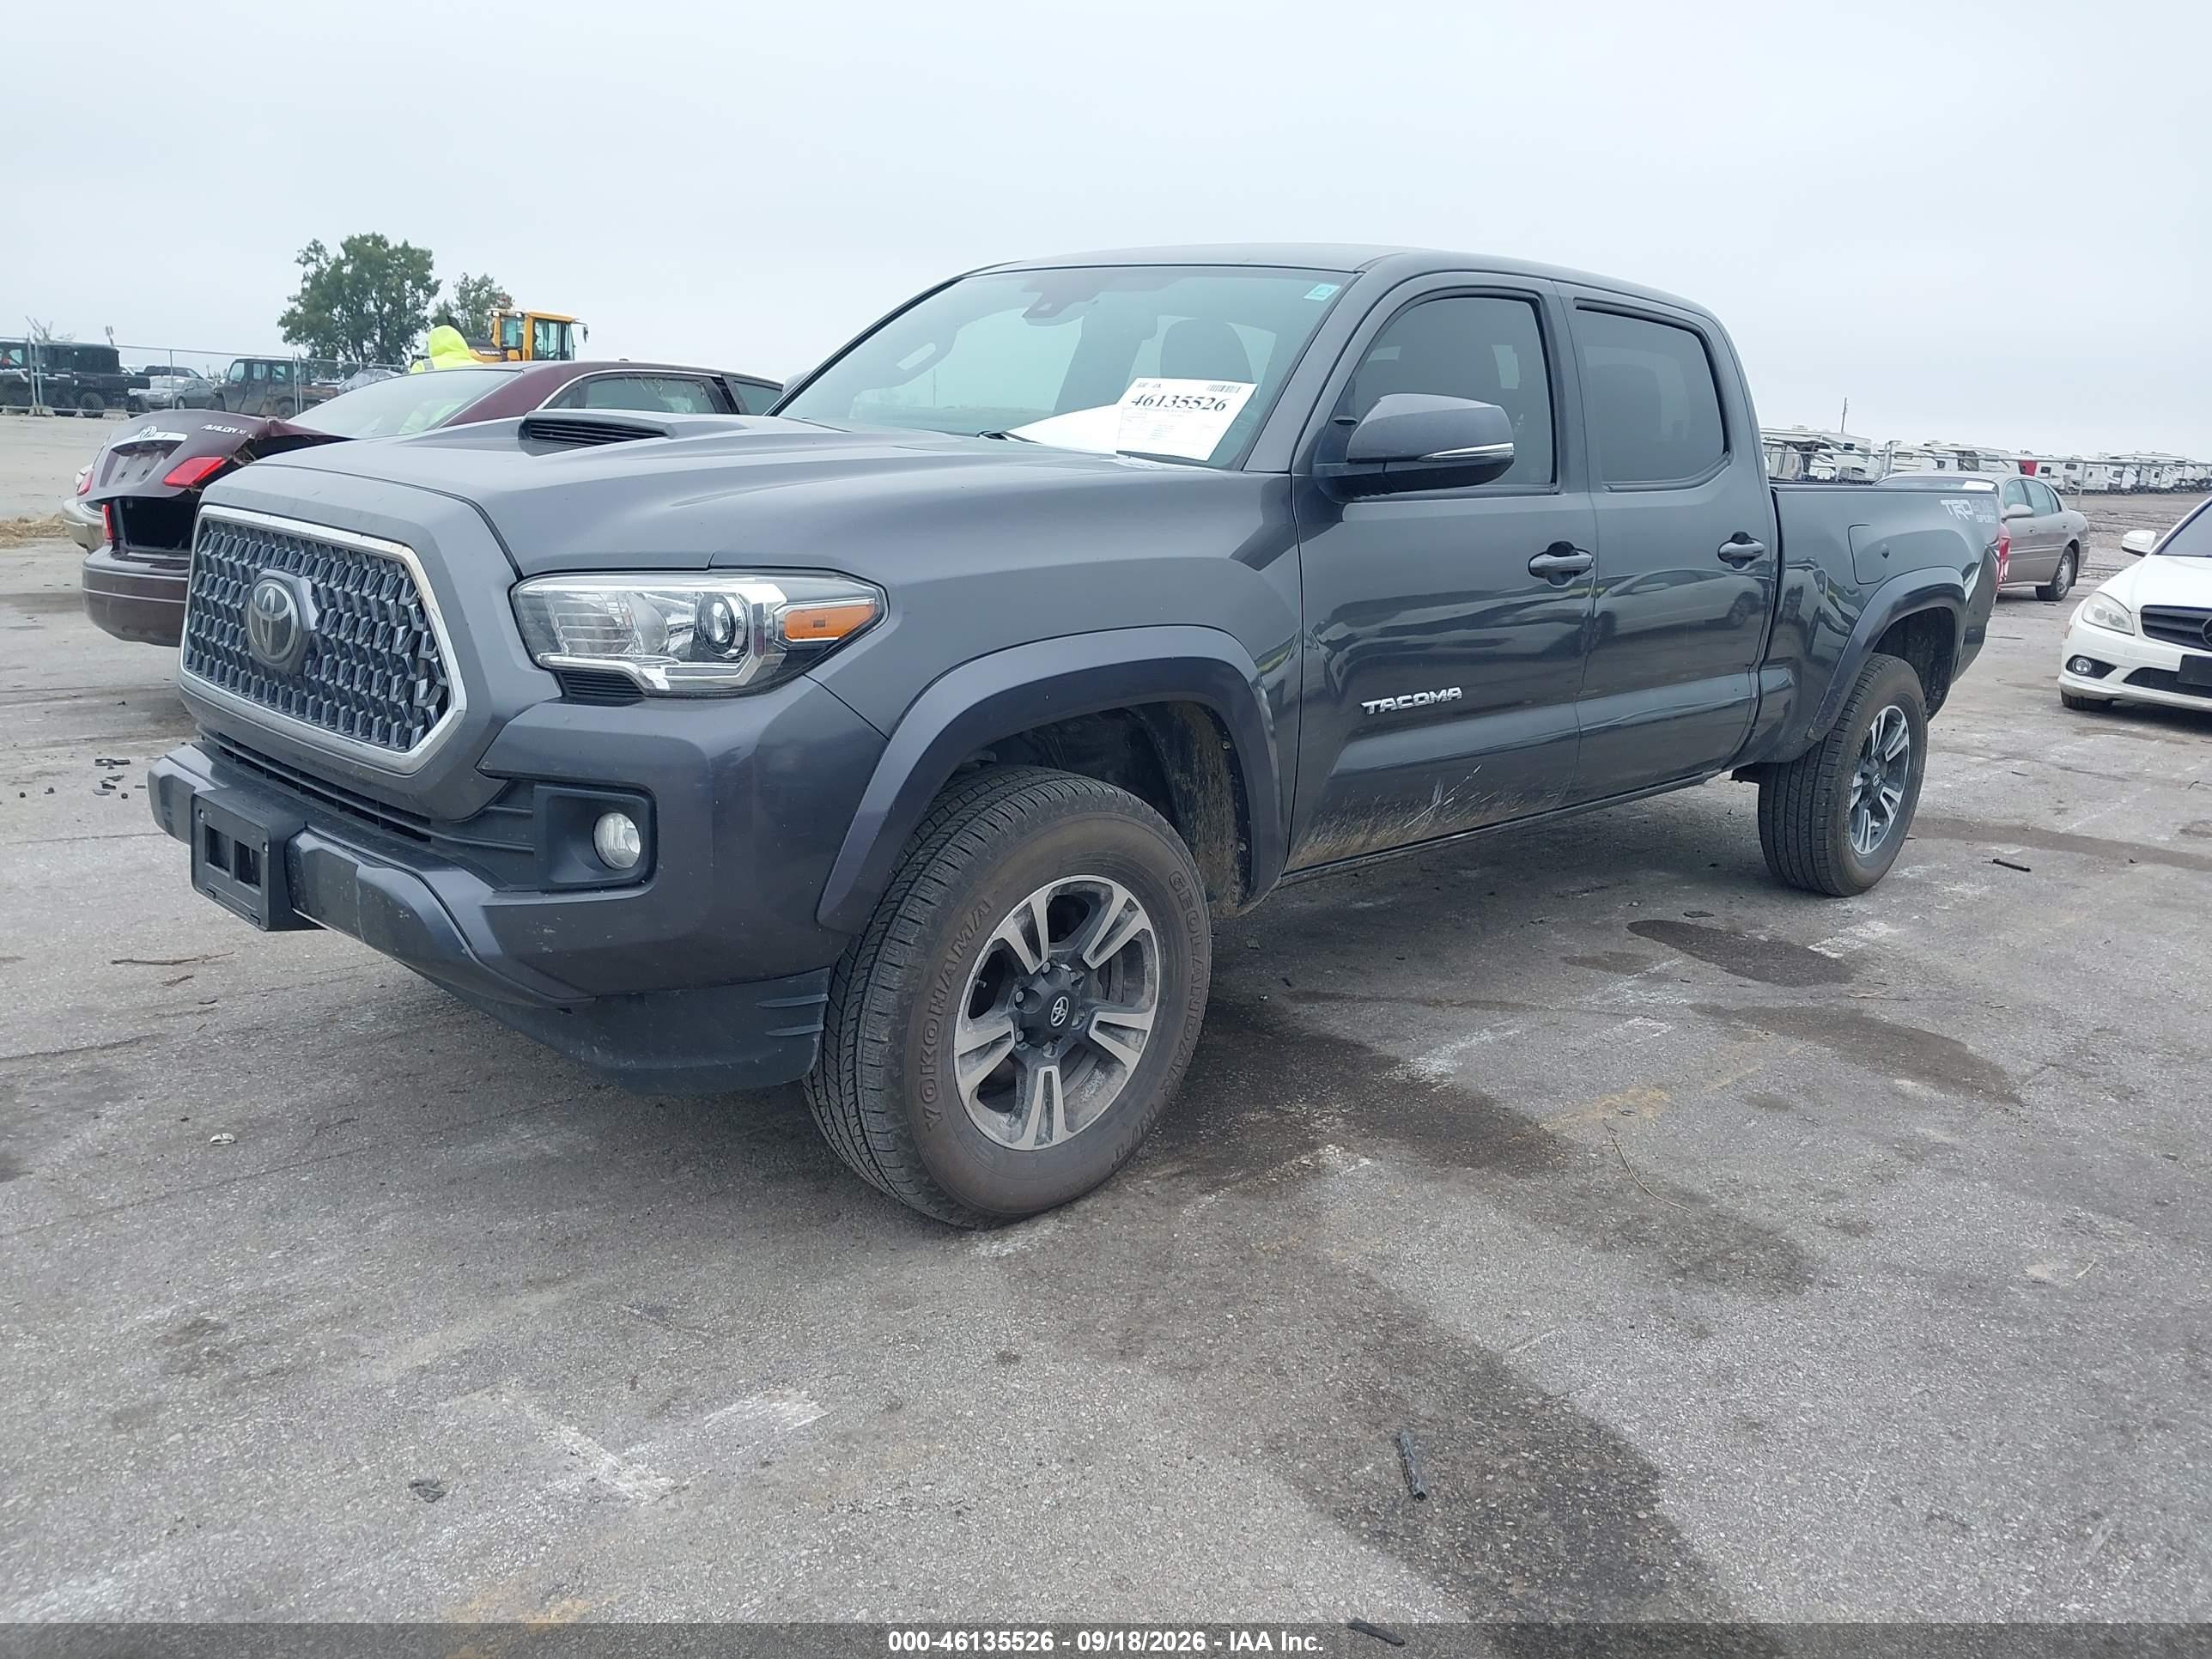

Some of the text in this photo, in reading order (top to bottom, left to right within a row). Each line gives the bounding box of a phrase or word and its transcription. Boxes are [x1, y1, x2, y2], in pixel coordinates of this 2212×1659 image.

[1131, 393, 1231, 412] 46135526
[1940, 499, 1974, 520] TRD
[1360, 686, 1462, 715] TACOMA
[920, 899, 993, 1133] YOKOHAMA
